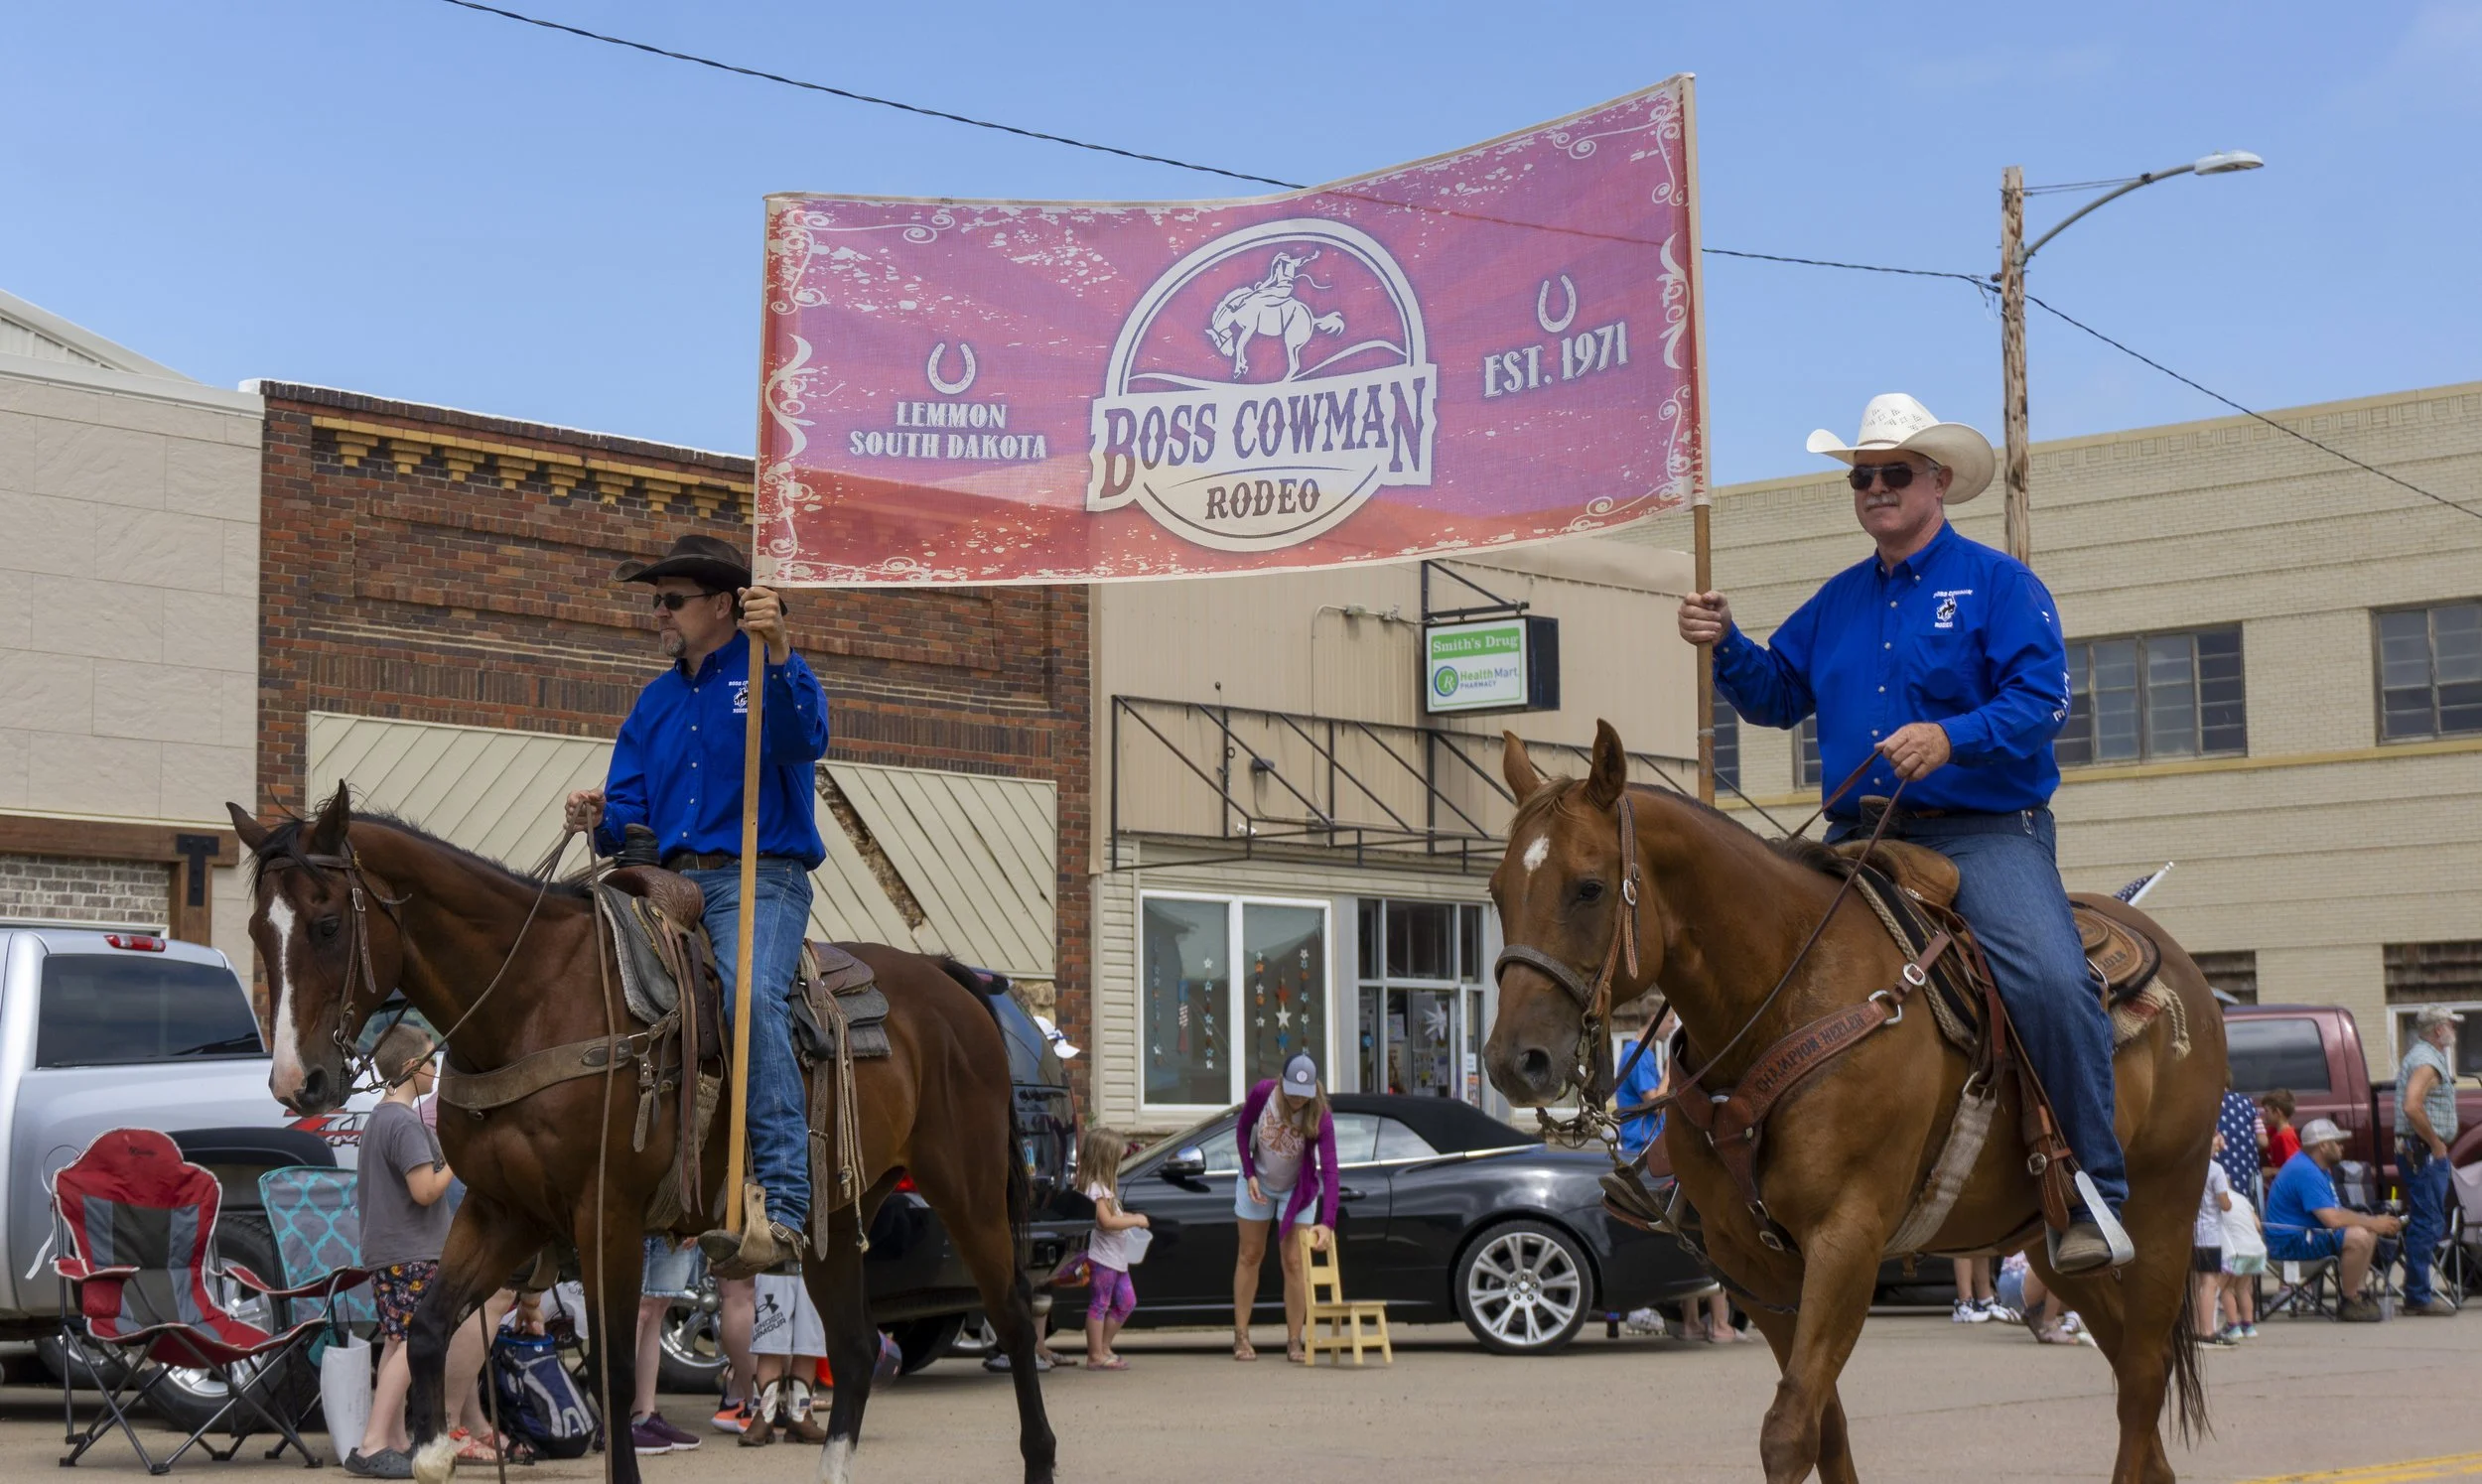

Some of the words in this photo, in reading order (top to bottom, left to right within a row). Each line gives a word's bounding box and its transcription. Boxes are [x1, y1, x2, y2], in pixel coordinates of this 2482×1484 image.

[1483, 344, 1553, 398] EST.
[1562, 321, 1629, 381] 1971
[896, 401, 1008, 429] LEMMON
[849, 430, 941, 459] SOUTH
[947, 434, 1047, 460] DAKOTA
[1099, 402, 1217, 498] BOSS
[1232, 376, 1427, 472] COWMAN
[1204, 477, 1321, 521] RODEO
[1433, 637, 1482, 653] Smith's
[1485, 634, 1519, 649] Drug
[1755, 1036, 1821, 1091] CHAMPION
[755, 1311, 783, 1332] UNDER
